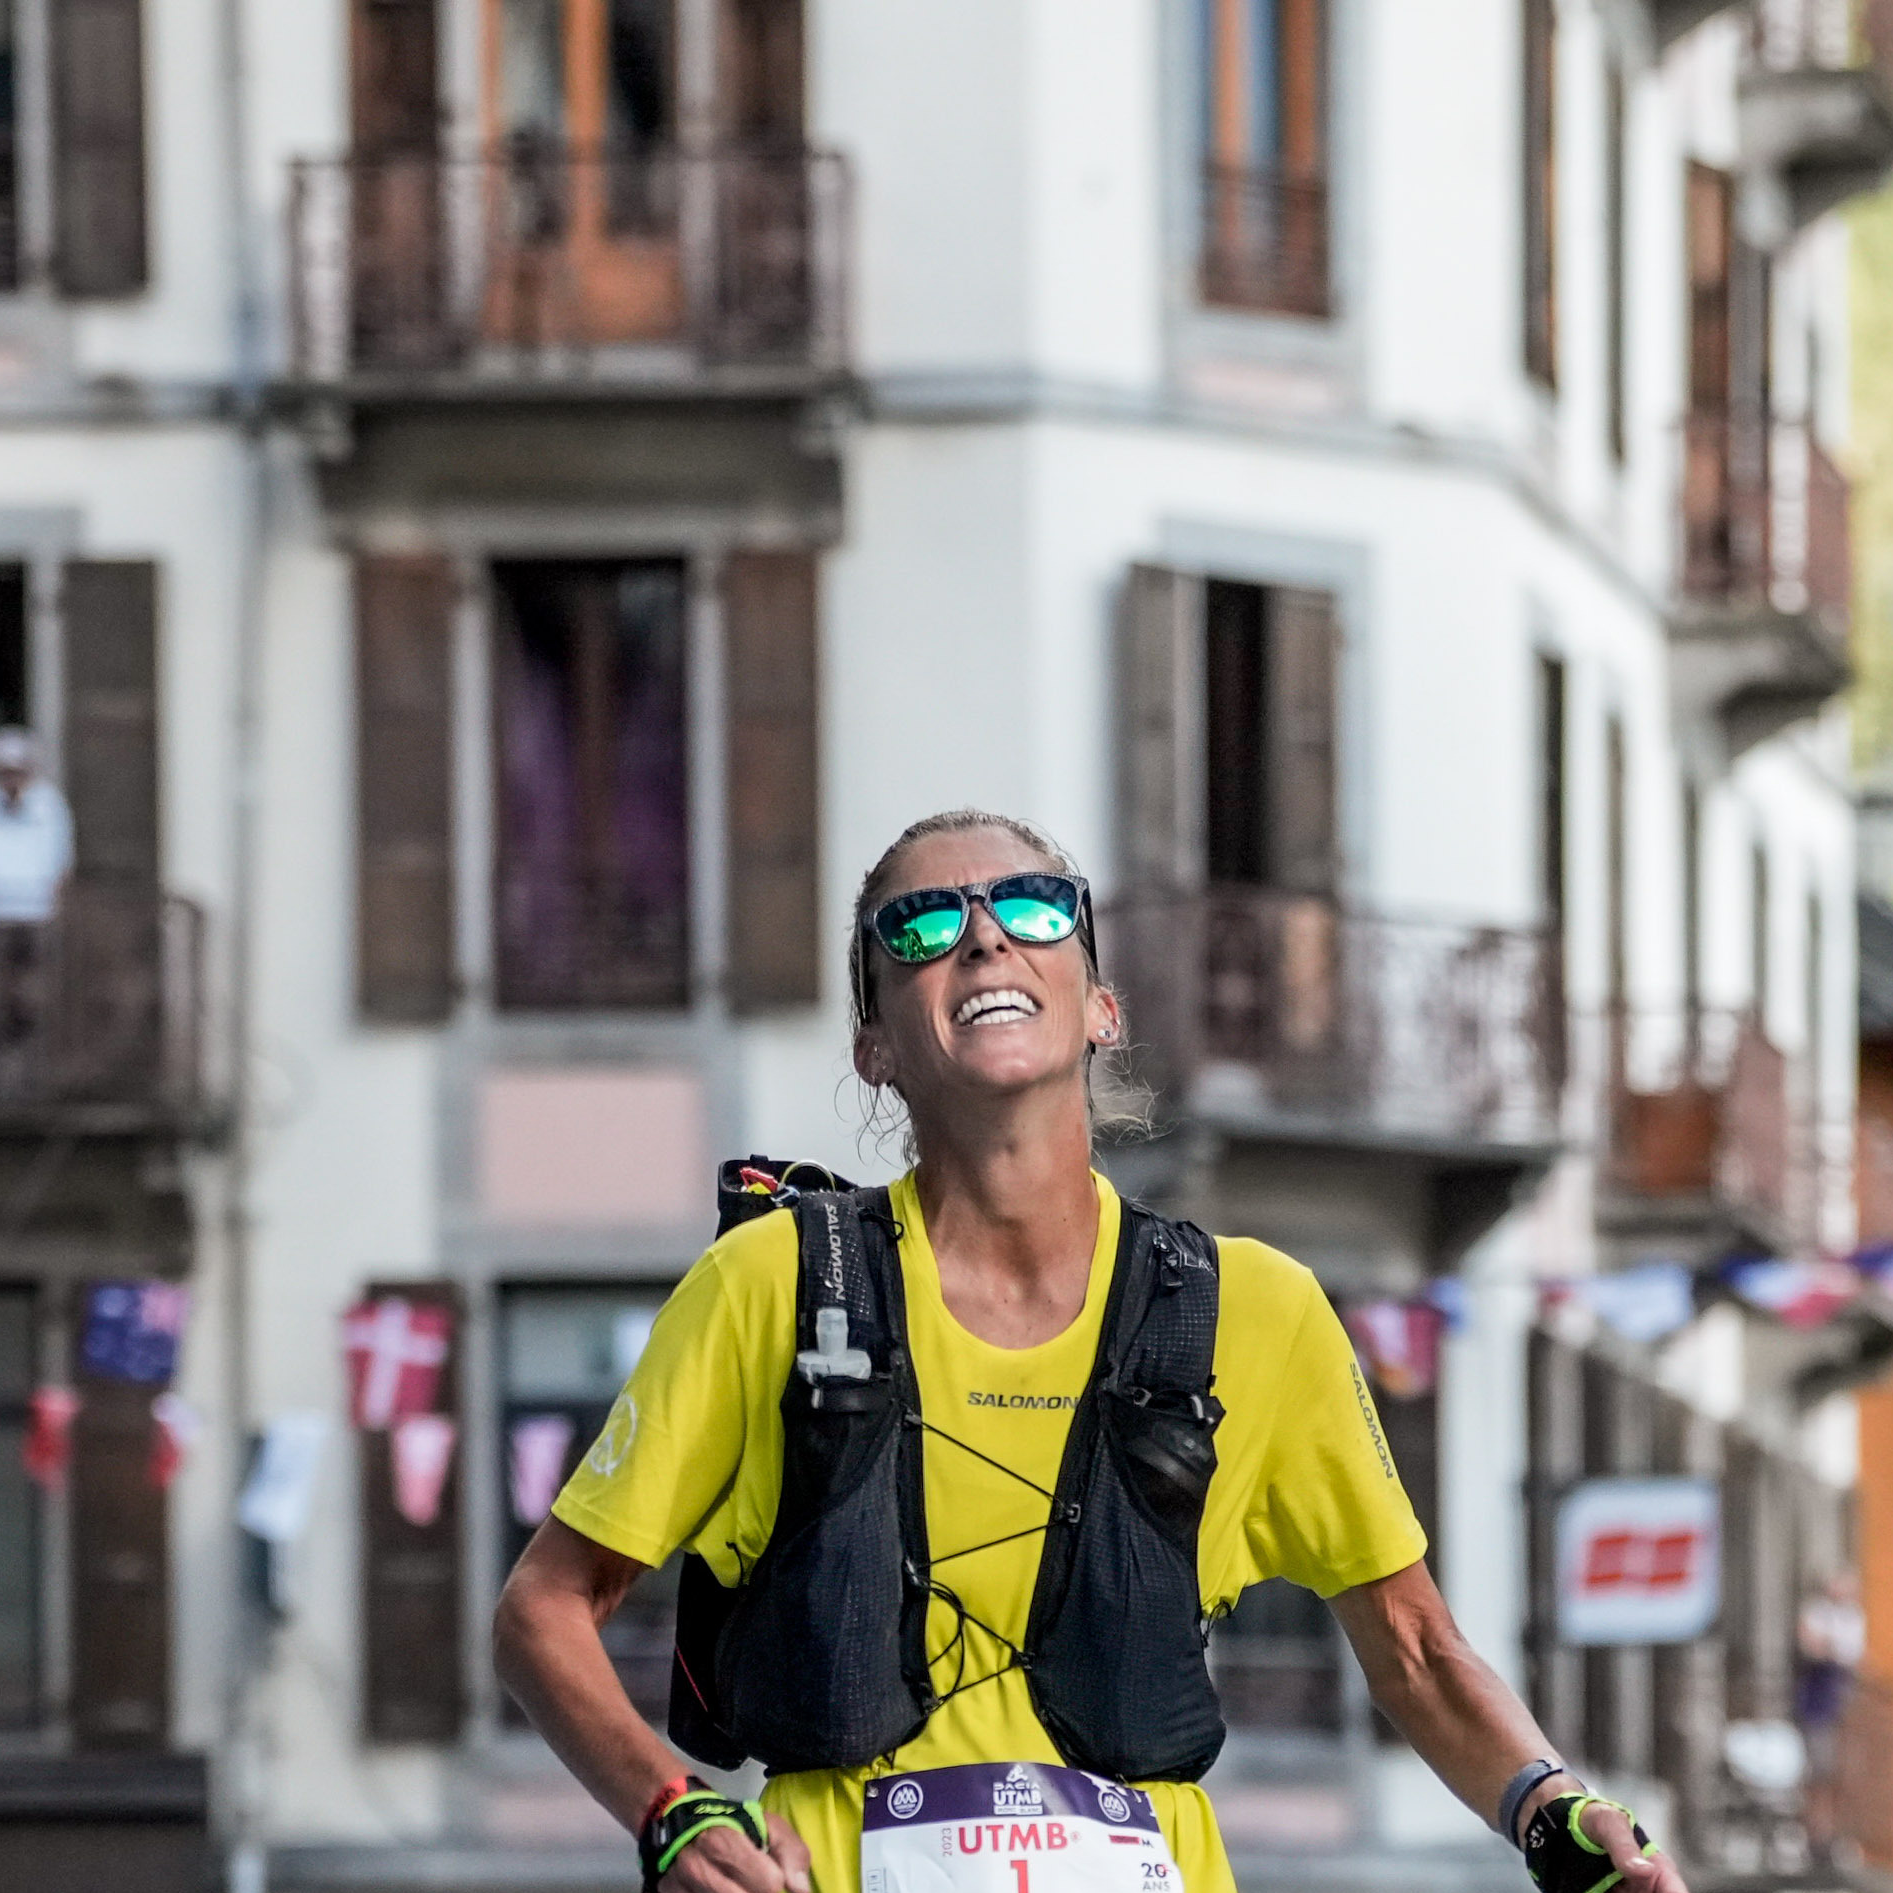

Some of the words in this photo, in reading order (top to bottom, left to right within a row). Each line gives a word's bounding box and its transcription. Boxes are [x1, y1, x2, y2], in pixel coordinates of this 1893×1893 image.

[825, 1203, 846, 1301] SALOMON
[967, 1391, 1079, 1410] SALOMON
[1350, 1362, 1393, 1479] SALOMON
[993, 1790, 1043, 1806] UTMB
[942, 1828, 953, 1857] 2023
[1142, 1880, 1171, 1893] ANS
